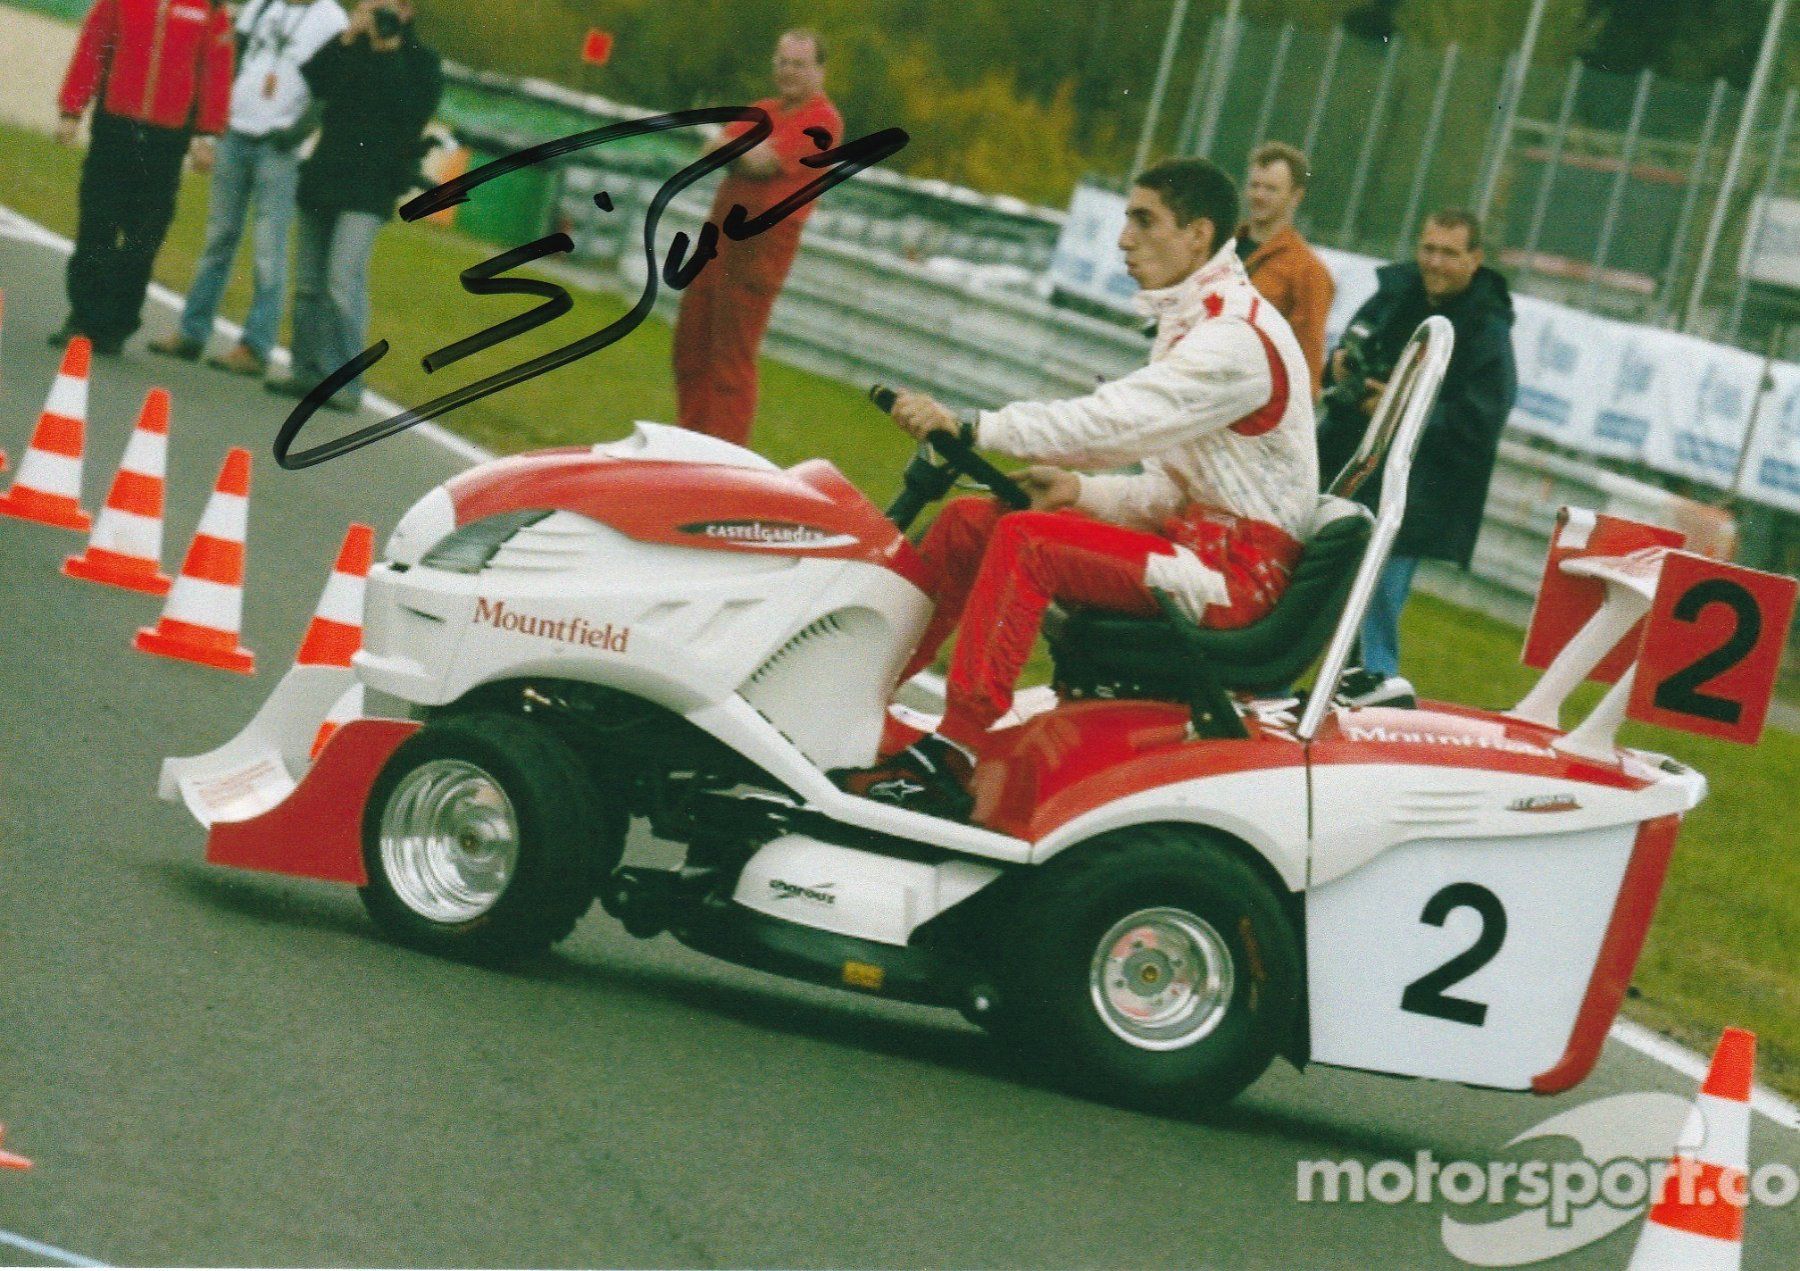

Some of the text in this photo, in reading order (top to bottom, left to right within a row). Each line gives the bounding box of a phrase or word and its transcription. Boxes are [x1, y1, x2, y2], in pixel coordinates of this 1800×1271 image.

[472, 596, 631, 652] Mountfield
[1654, 578, 1763, 725] 2
[1400, 881, 1508, 1028] 2
